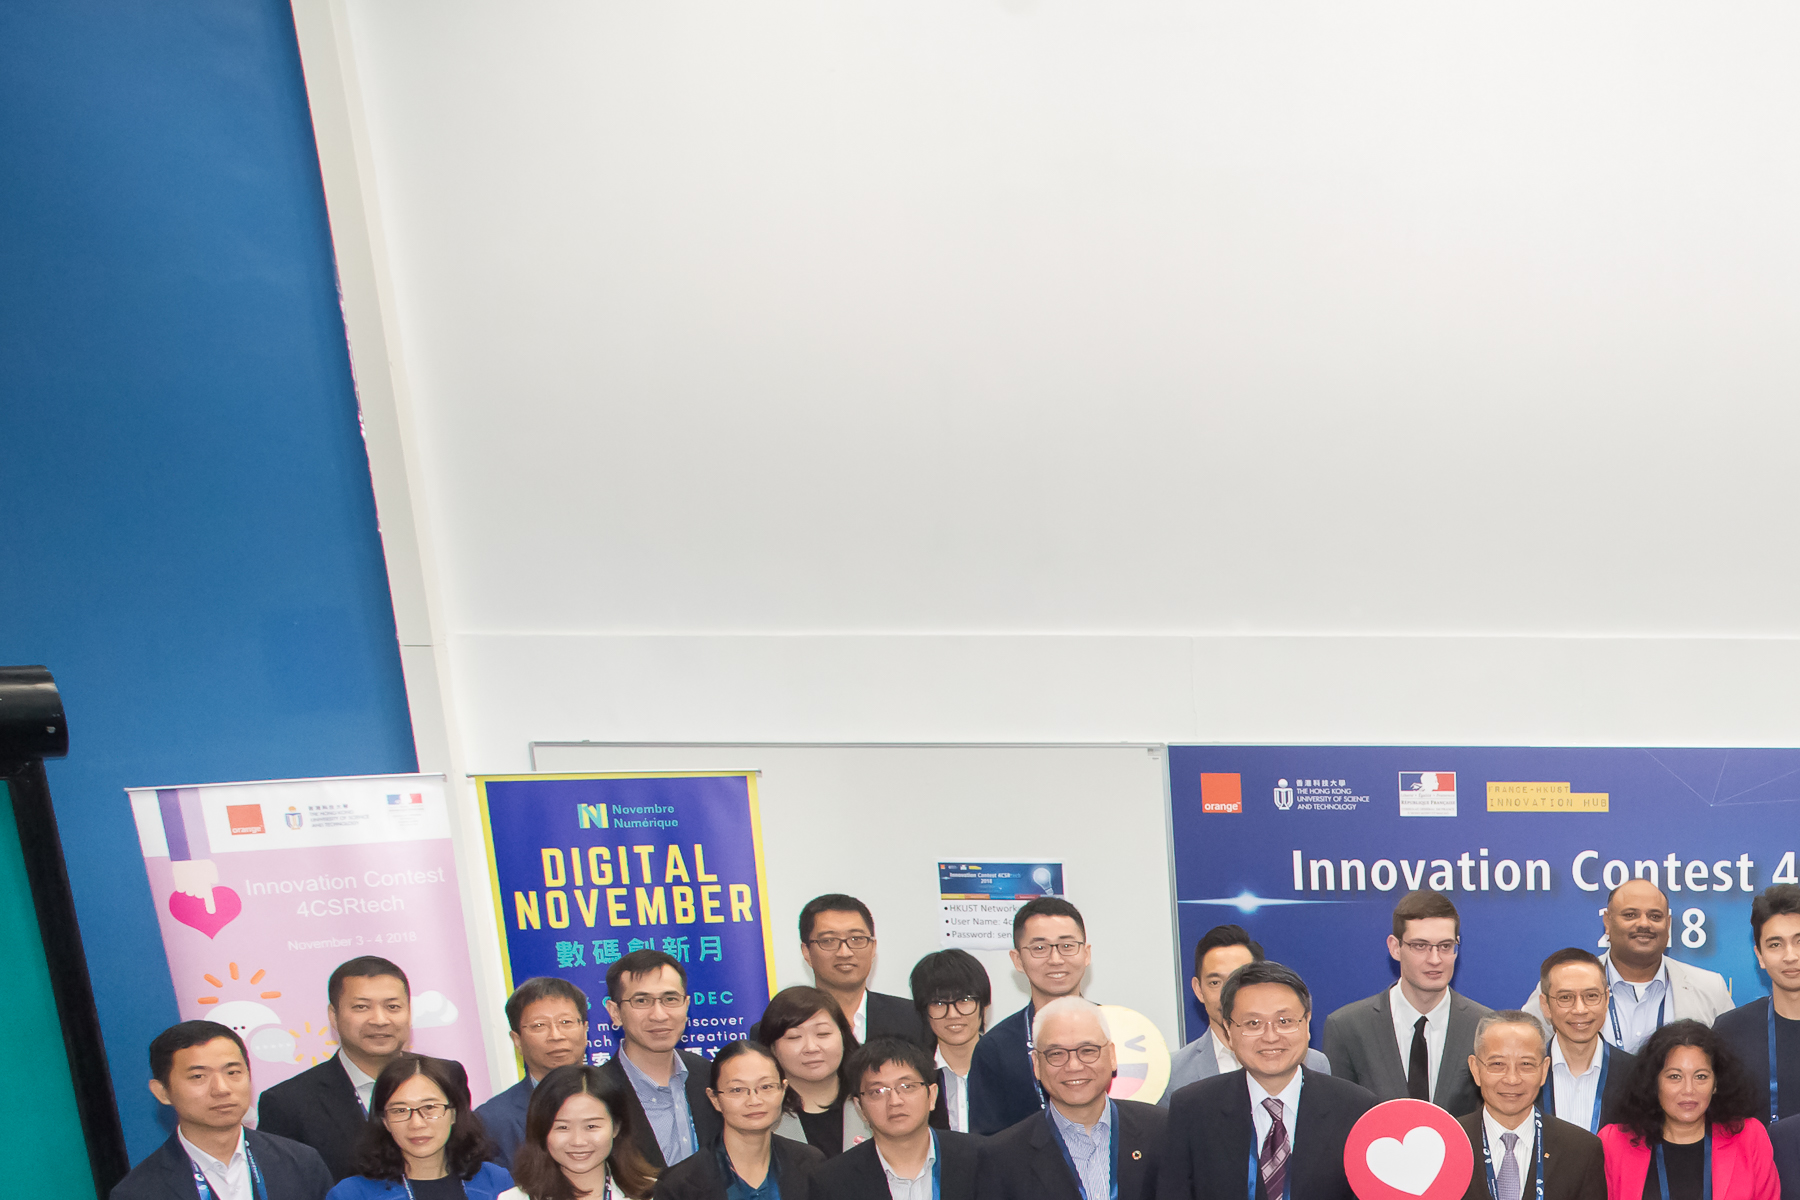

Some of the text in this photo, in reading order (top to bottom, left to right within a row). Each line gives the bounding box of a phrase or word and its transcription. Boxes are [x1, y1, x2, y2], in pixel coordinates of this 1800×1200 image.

[1490, 798, 1607, 807] INNOVATION HUB
[612, 804, 675, 815] Novembre
[613, 817, 679, 830] Numérique
[541, 844, 718, 888] DIGITAL
[1292, 847, 1553, 892] Innovation
[1572, 850, 1755, 892] Contest
[245, 867, 445, 896] Innovation Contest
[296, 895, 405, 917] 4CSRtech
[514, 884, 754, 930] NOVEMBER
[949, 904, 978, 912] HKUST
[950, 918, 970, 926] User
[973, 918, 1001, 926] Name:
[287, 937, 352, 951] November
[356, 935, 364, 945] 3
[374, 934, 383, 944] 4
[386, 931, 417, 943] 2018
[951, 930, 995, 939] Password:
[693, 991, 734, 1005] DEC
[687, 1017, 744, 1027] iscover
[681, 1031, 748, 1043] creation
